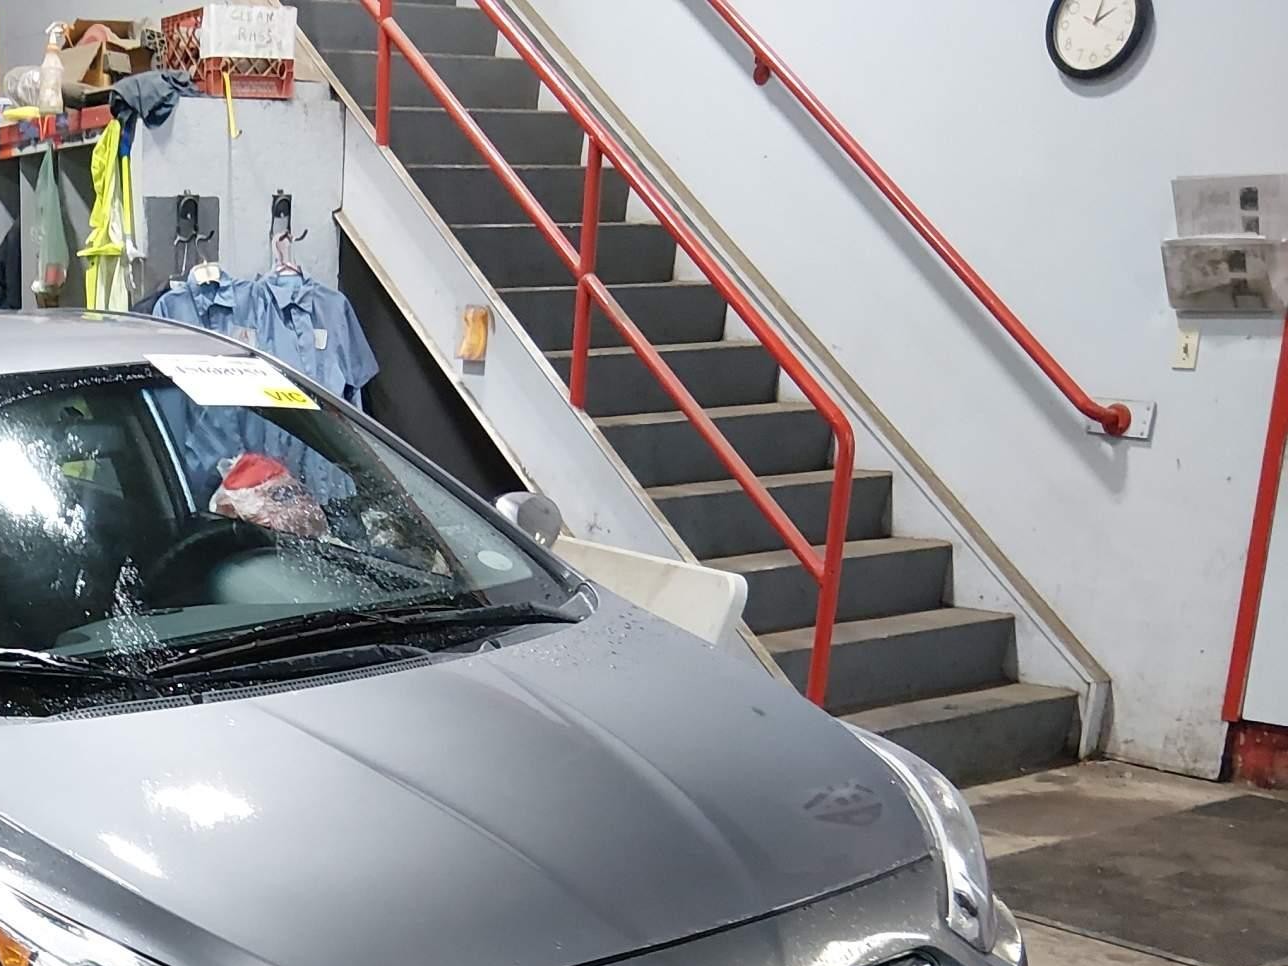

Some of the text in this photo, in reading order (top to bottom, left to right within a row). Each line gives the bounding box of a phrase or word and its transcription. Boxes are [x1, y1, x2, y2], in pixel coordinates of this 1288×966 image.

[1116, 31, 1124, 41] 4
[1065, 37, 1072, 51] 8
[1104, 44, 1112, 58] 5
[1077, 48, 1084, 62] 7
[1089, 51, 1097, 63] 6
[264, 389, 308, 404] VIC
